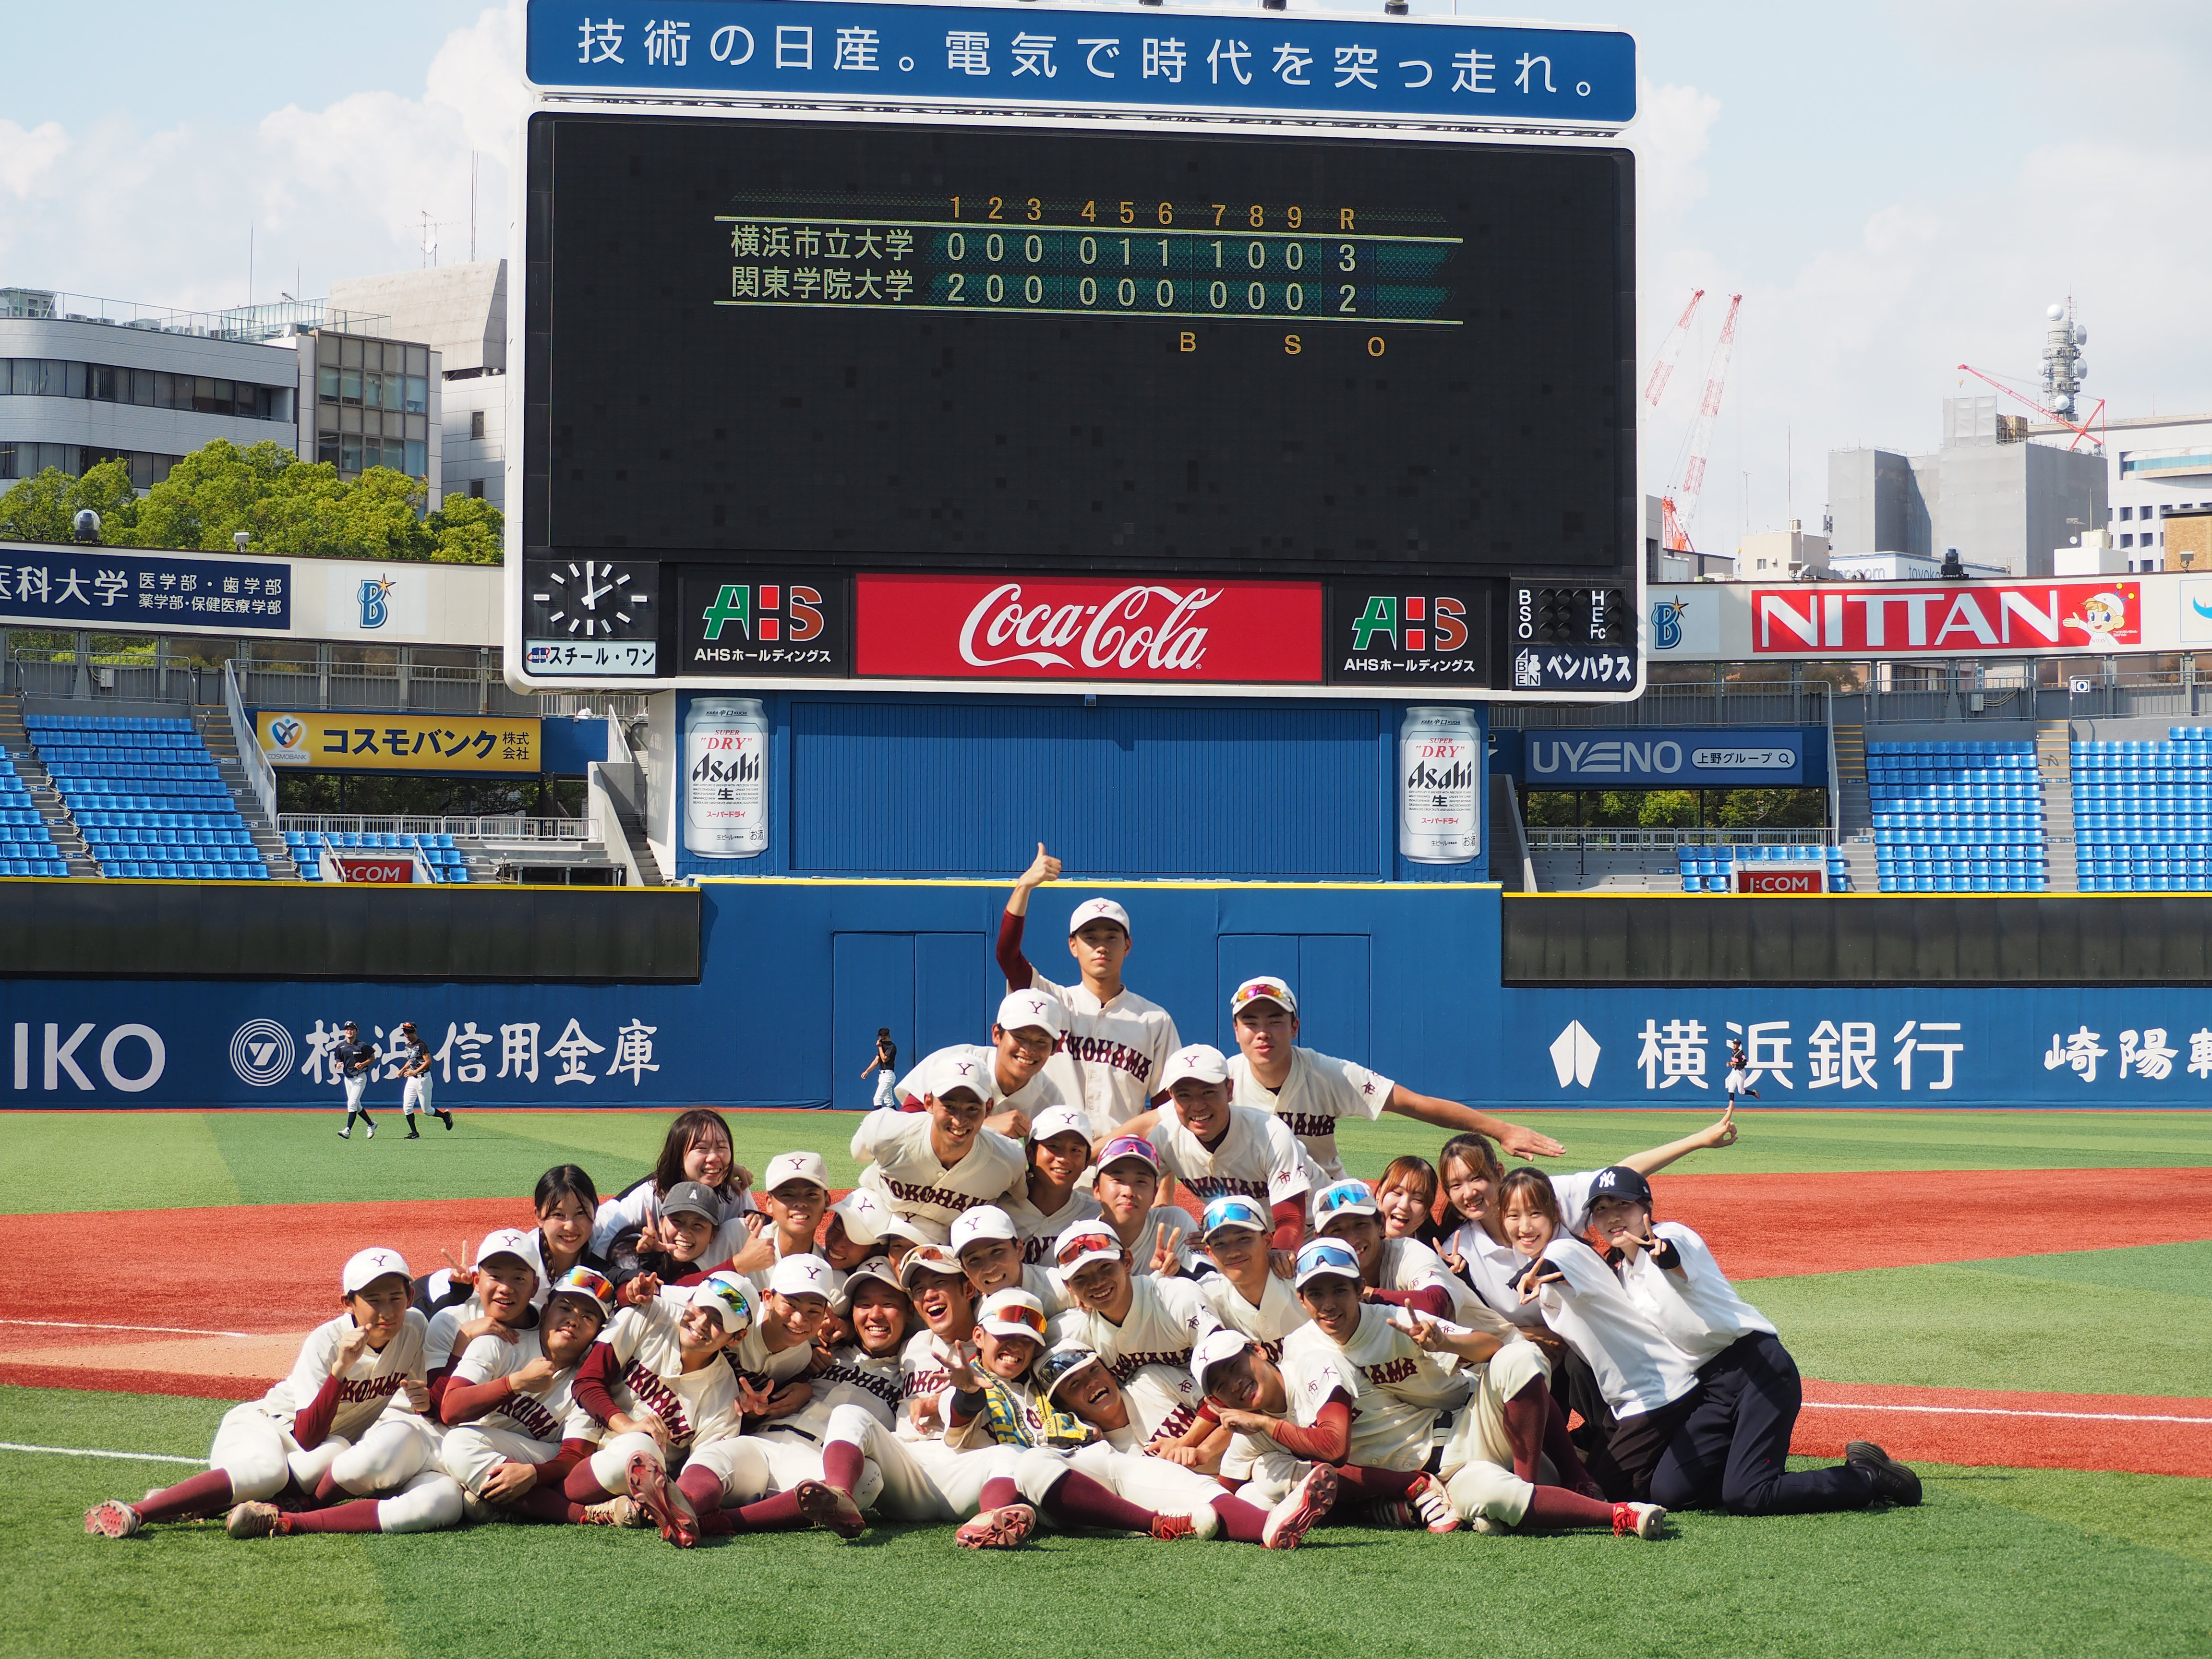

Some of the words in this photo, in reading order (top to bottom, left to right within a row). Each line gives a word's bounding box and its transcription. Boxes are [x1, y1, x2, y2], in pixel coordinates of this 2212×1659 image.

[577, 17, 1592, 98] 技術の日産。電気で時代を突っ走れ。
[950, 197, 960, 217] 1
[989, 197, 1002, 219] 2
[1027, 198, 1041, 220] 3
[1081, 201, 1096, 222] 4
[1120, 202, 1134, 223] 5
[1158, 203, 1172, 224] 6
[1212, 204, 1226, 226] 7
[1250, 205, 1263, 227] 8
[1288, 206, 1301, 228] 9
[1341, 208, 1354, 229] R
[731, 224, 914, 261] 横浜市立大学
[948, 233, 965, 260] 0
[986, 234, 1004, 261] 0
[1025, 235, 1042, 263] 0
[1080, 237, 1097, 264] 0
[1119, 239, 1130, 265] 1
[1157, 240, 1168, 266] 1
[1211, 241, 1222, 268] 1
[1249, 242, 1265, 269] 0
[1286, 243, 1303, 270] 0
[1339, 244, 1356, 272] 3
[732, 265, 914, 301] 関東学院大学
[948, 274, 965, 301] 2
[986, 275, 1004, 302] 0
[1025, 276, 1042, 303] 0
[1080, 277, 1097, 305] 0
[1118, 278, 1135, 306] 0
[1157, 279, 1174, 307] 0
[1210, 281, 1227, 309] 0
[1249, 282, 1265, 310] 0
[1286, 283, 1303, 311] 0
[1339, 285, 1356, 313] 2
[1180, 332, 1196, 351] B
[1285, 335, 1301, 354] S
[139, 572, 282, 596] 医学部・歯学部
[138, 593, 282, 615] 薬学部・保健医療学部
[1519, 589, 1531, 605] B
[1592, 590, 1604, 606] H
[1519, 606, 1531, 622] S
[1592, 607, 1604, 623] E
[1761, 590, 2059, 648] NITTAN
[959, 583, 1225, 669] Coca-Cola
[549, 647, 655, 666] スチール・ワン
[694, 648, 832, 663] AHSホールディングス
[1344, 658, 1476, 672] AHSホールディングス
[1547, 653, 1632, 682] ベンハウス
[323, 729, 498, 759] コスモバンク
[502, 731, 529, 745] 株式
[502, 746, 529, 760] 会社
[1533, 741, 1682, 773] UYENO
[1697, 752, 1773, 765] 上野グループ
[693, 752, 759, 782] Asahi
[1408, 760, 1472, 790] Asahi
[717, 788, 734, 800] 生
[1432, 795, 1448, 806] 生
[1093, 903, 1109, 913] Y
[1029, 1001, 1046, 1014] Y
[14, 1022, 166, 1093] IKO
[1183, 1056, 1200, 1068] Y
[1638, 1019, 1964, 1090] 横浜銀行
[956, 1062, 974, 1076] Y
[1060, 1113, 1078, 1124] Y
[788, 1158, 807, 1170] Y
[858, 1197, 875, 1213] Y
[964, 1216, 980, 1231] Y
[502, 1236, 520, 1247] Y
[371, 1255, 387, 1267] Y
[865, 1262, 884, 1273] Y
[804, 1266, 822, 1280] Y
